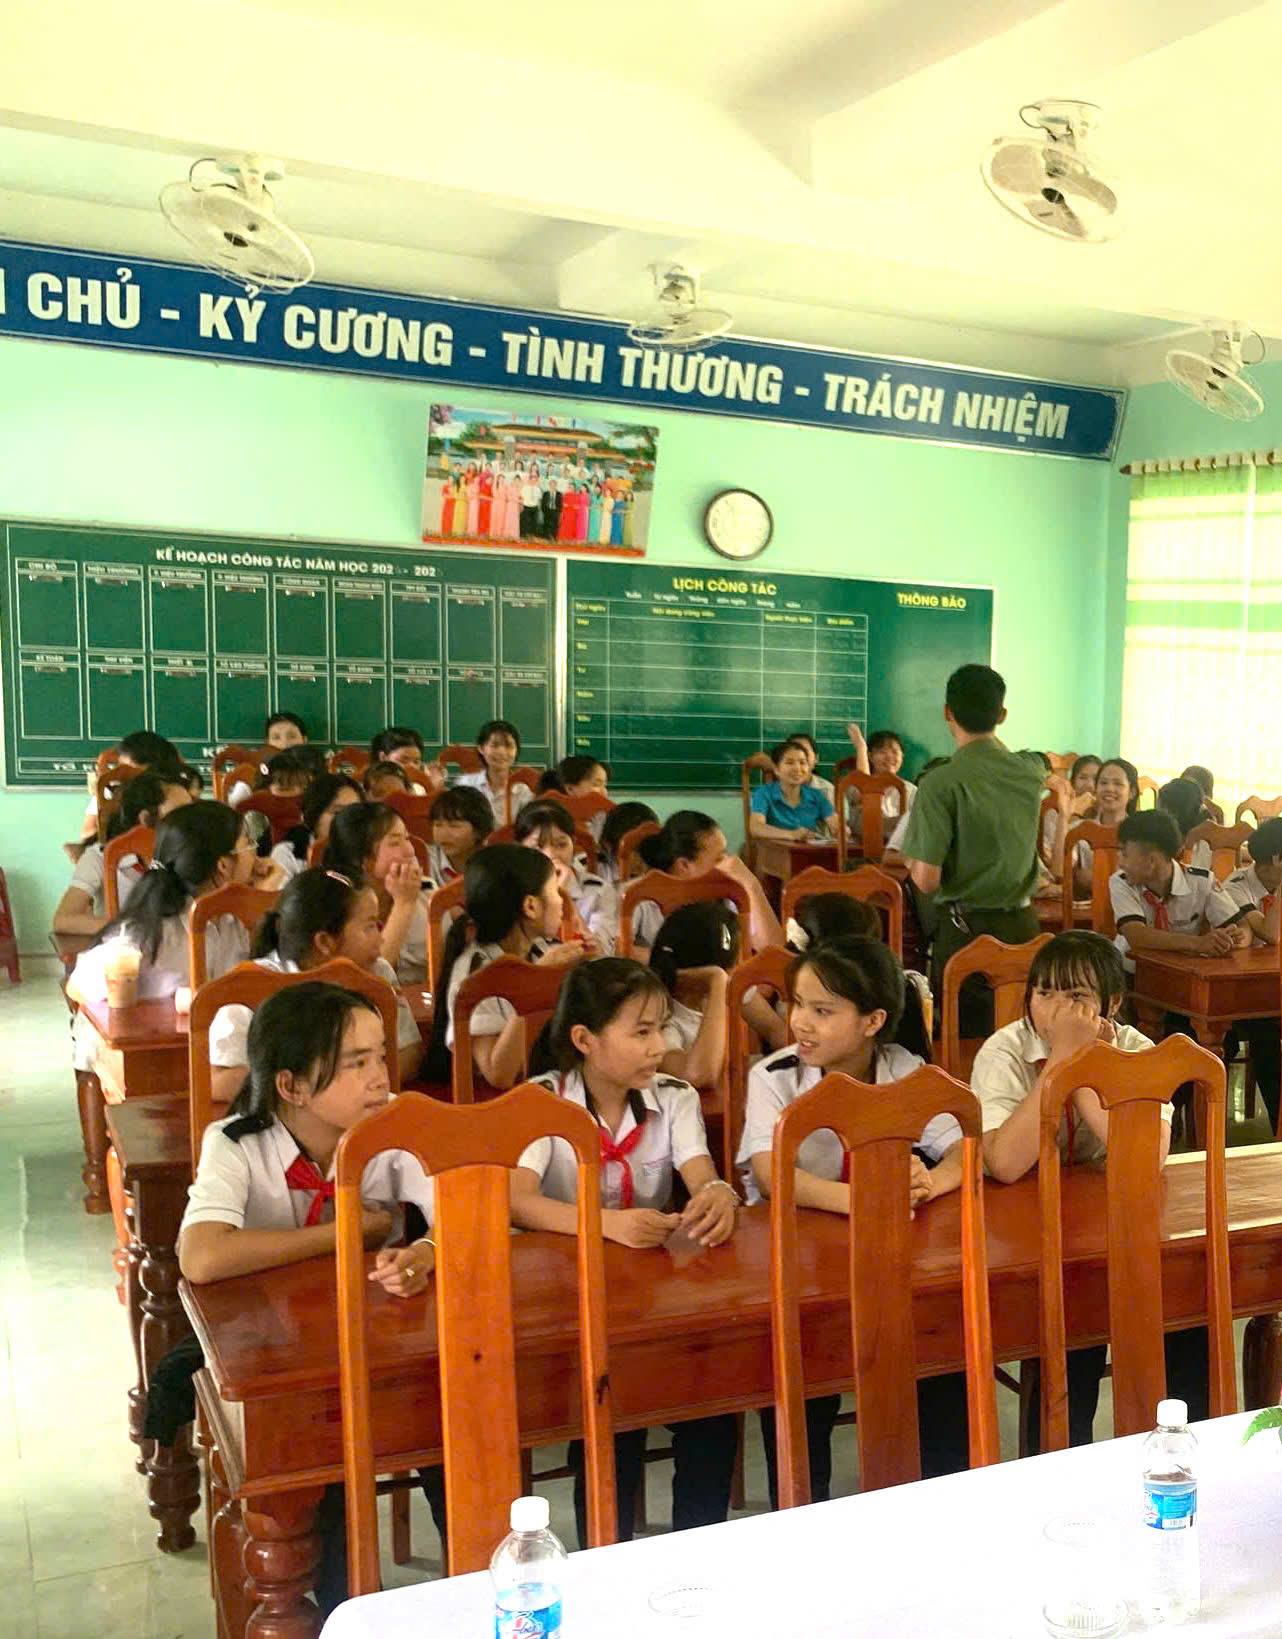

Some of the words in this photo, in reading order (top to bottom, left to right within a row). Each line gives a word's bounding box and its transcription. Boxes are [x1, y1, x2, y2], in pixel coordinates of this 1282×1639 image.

[27, 267, 141, 329] CHỦ
[199, 284, 267, 344] KỶ
[283, 304, 454, 367] CƯƠNG
[502, 326, 606, 384] TÌNH
[618, 346, 785, 405] THƯƠNG
[823, 372, 946, 425] TRÁCH
[951, 391, 1071, 443] NHIỆM
[156, 544, 175, 561] KẾ
[175, 549, 228, 566] HOẠCH
[231, 552, 273, 568] CÔNG
[276, 555, 302, 570] TÁC
[305, 558, 337, 572] NĂM
[339, 561, 369, 576] HỌC
[372, 563, 394, 575] 202
[414, 565, 437, 577] 202
[672, 577, 704, 593] LỊCH
[707, 577, 748, 594] CÔNG
[751, 580, 778, 596] TÁC
[897, 592, 939, 607] THÔNG
[941, 594, 967, 609] BÁO
